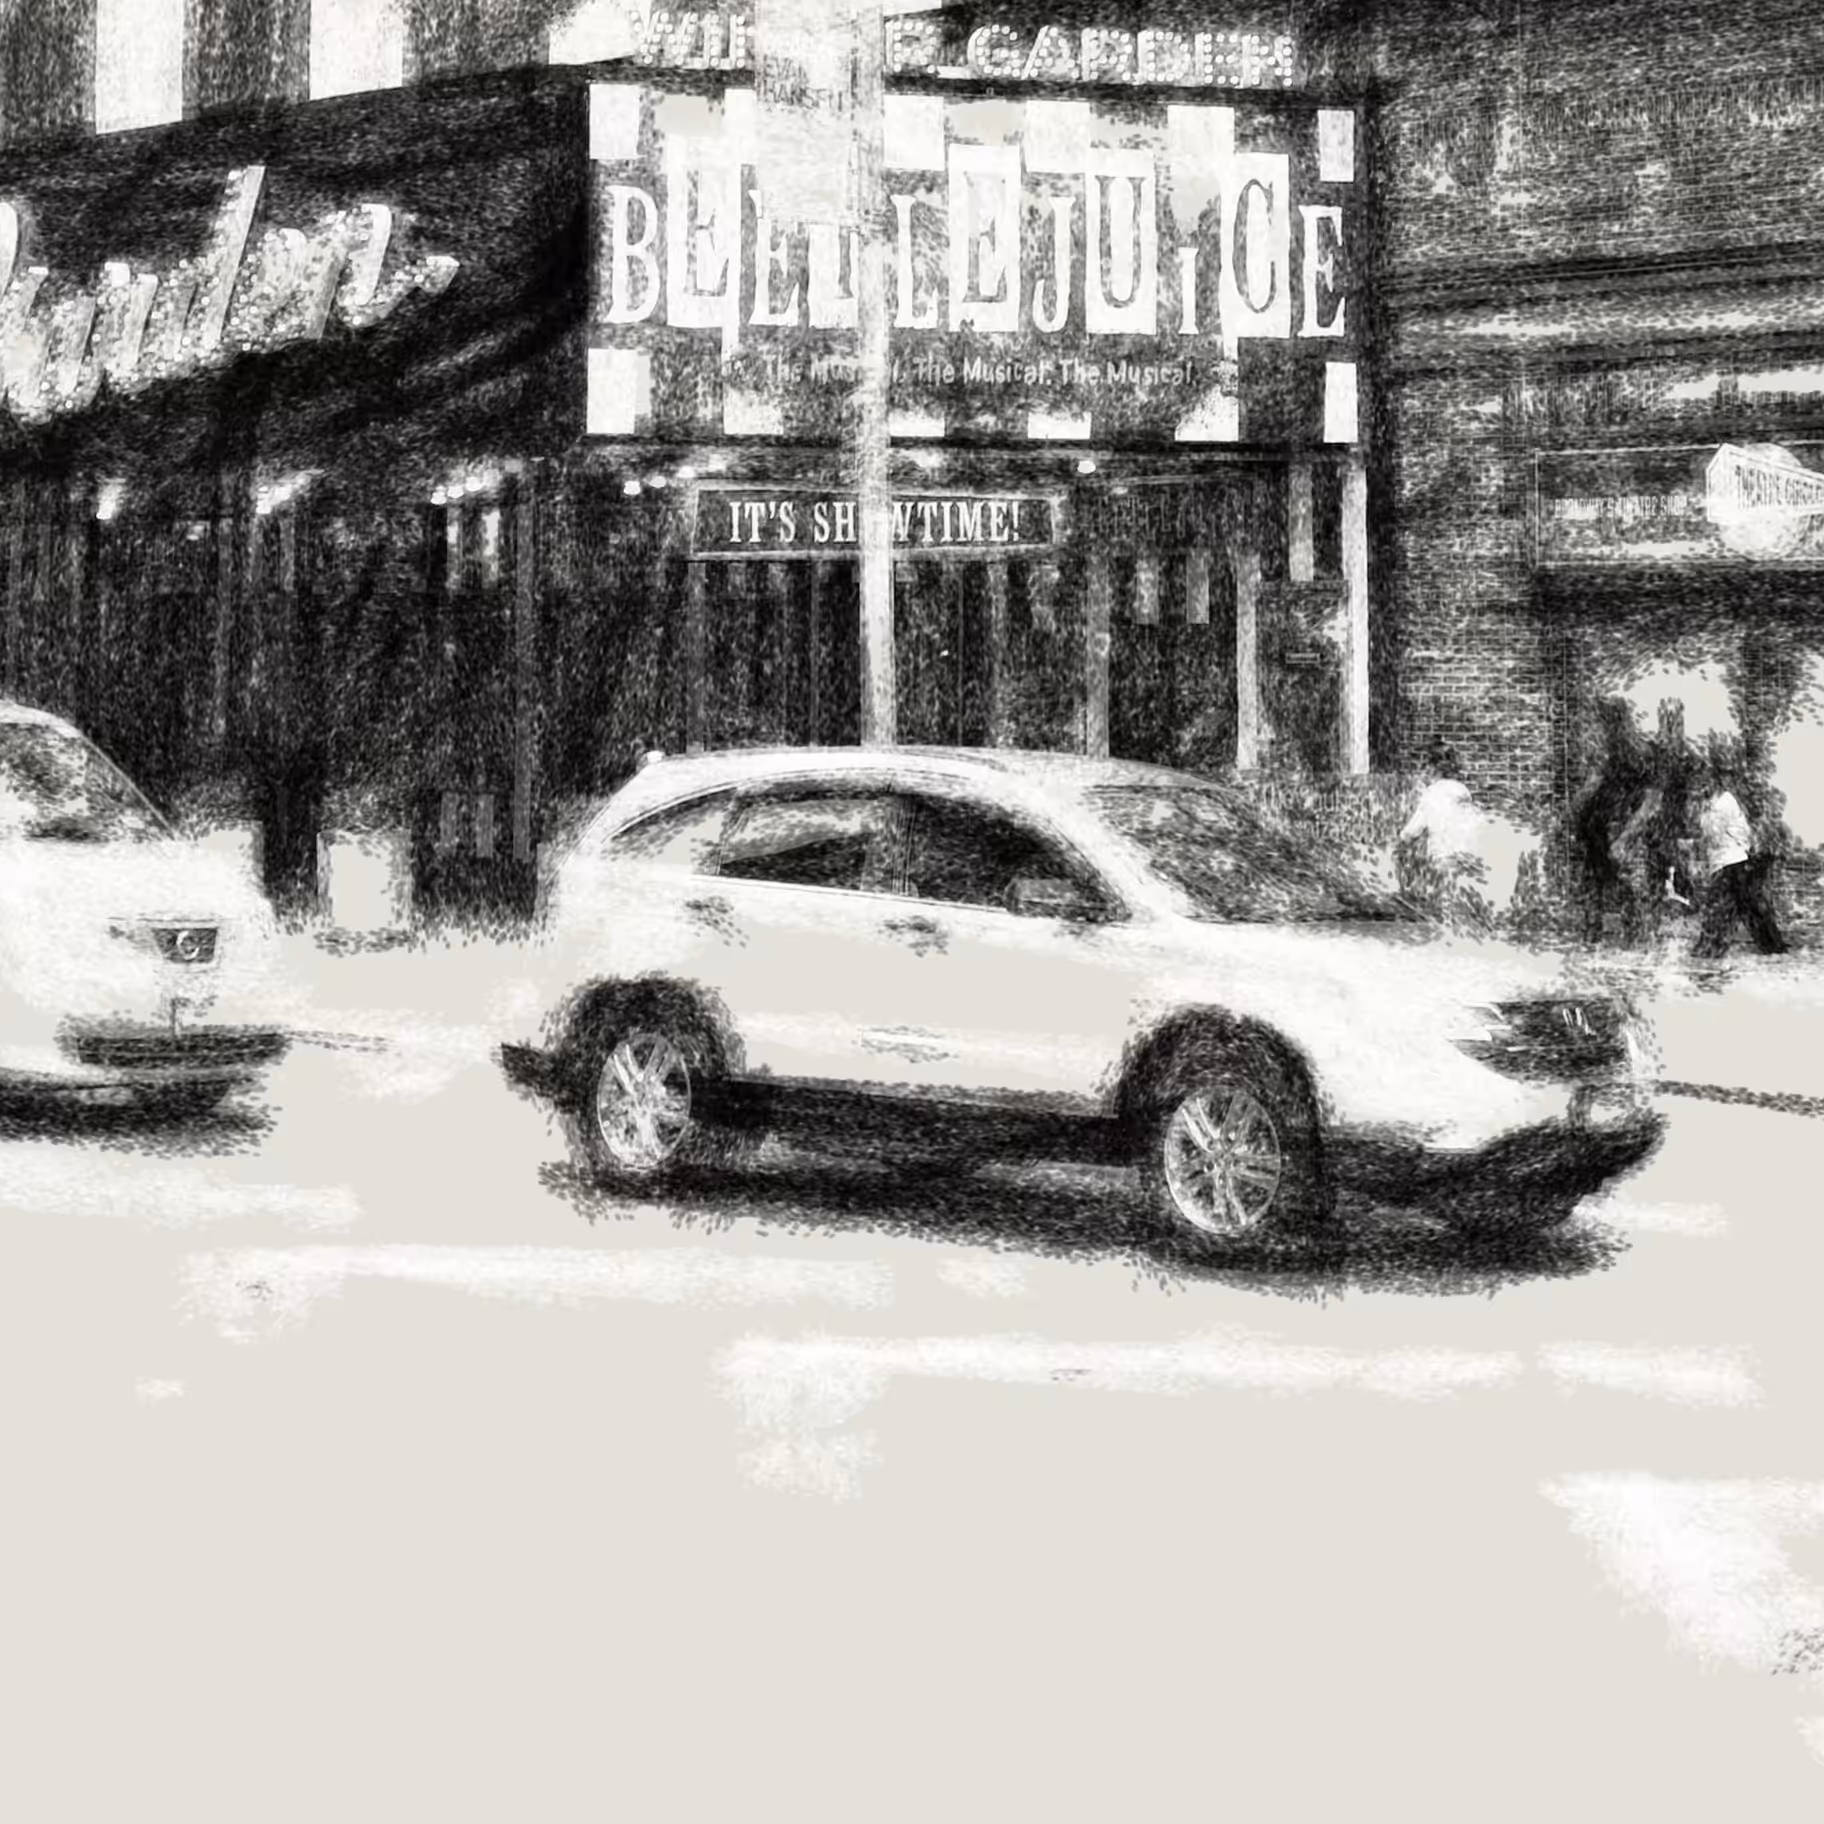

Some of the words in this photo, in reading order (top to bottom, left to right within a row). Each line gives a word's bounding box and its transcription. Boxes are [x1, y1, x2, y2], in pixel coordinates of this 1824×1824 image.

[629, 10, 938, 74] WIR
[967, 24, 1294, 86] GARDEN
[810, 352, 906, 384] Musl.
[913, 356, 954, 383] The
[1059, 360, 1098, 385] The
[729, 500, 796, 544] IT'S
[812, 500, 1021, 545] SHWTIME!
